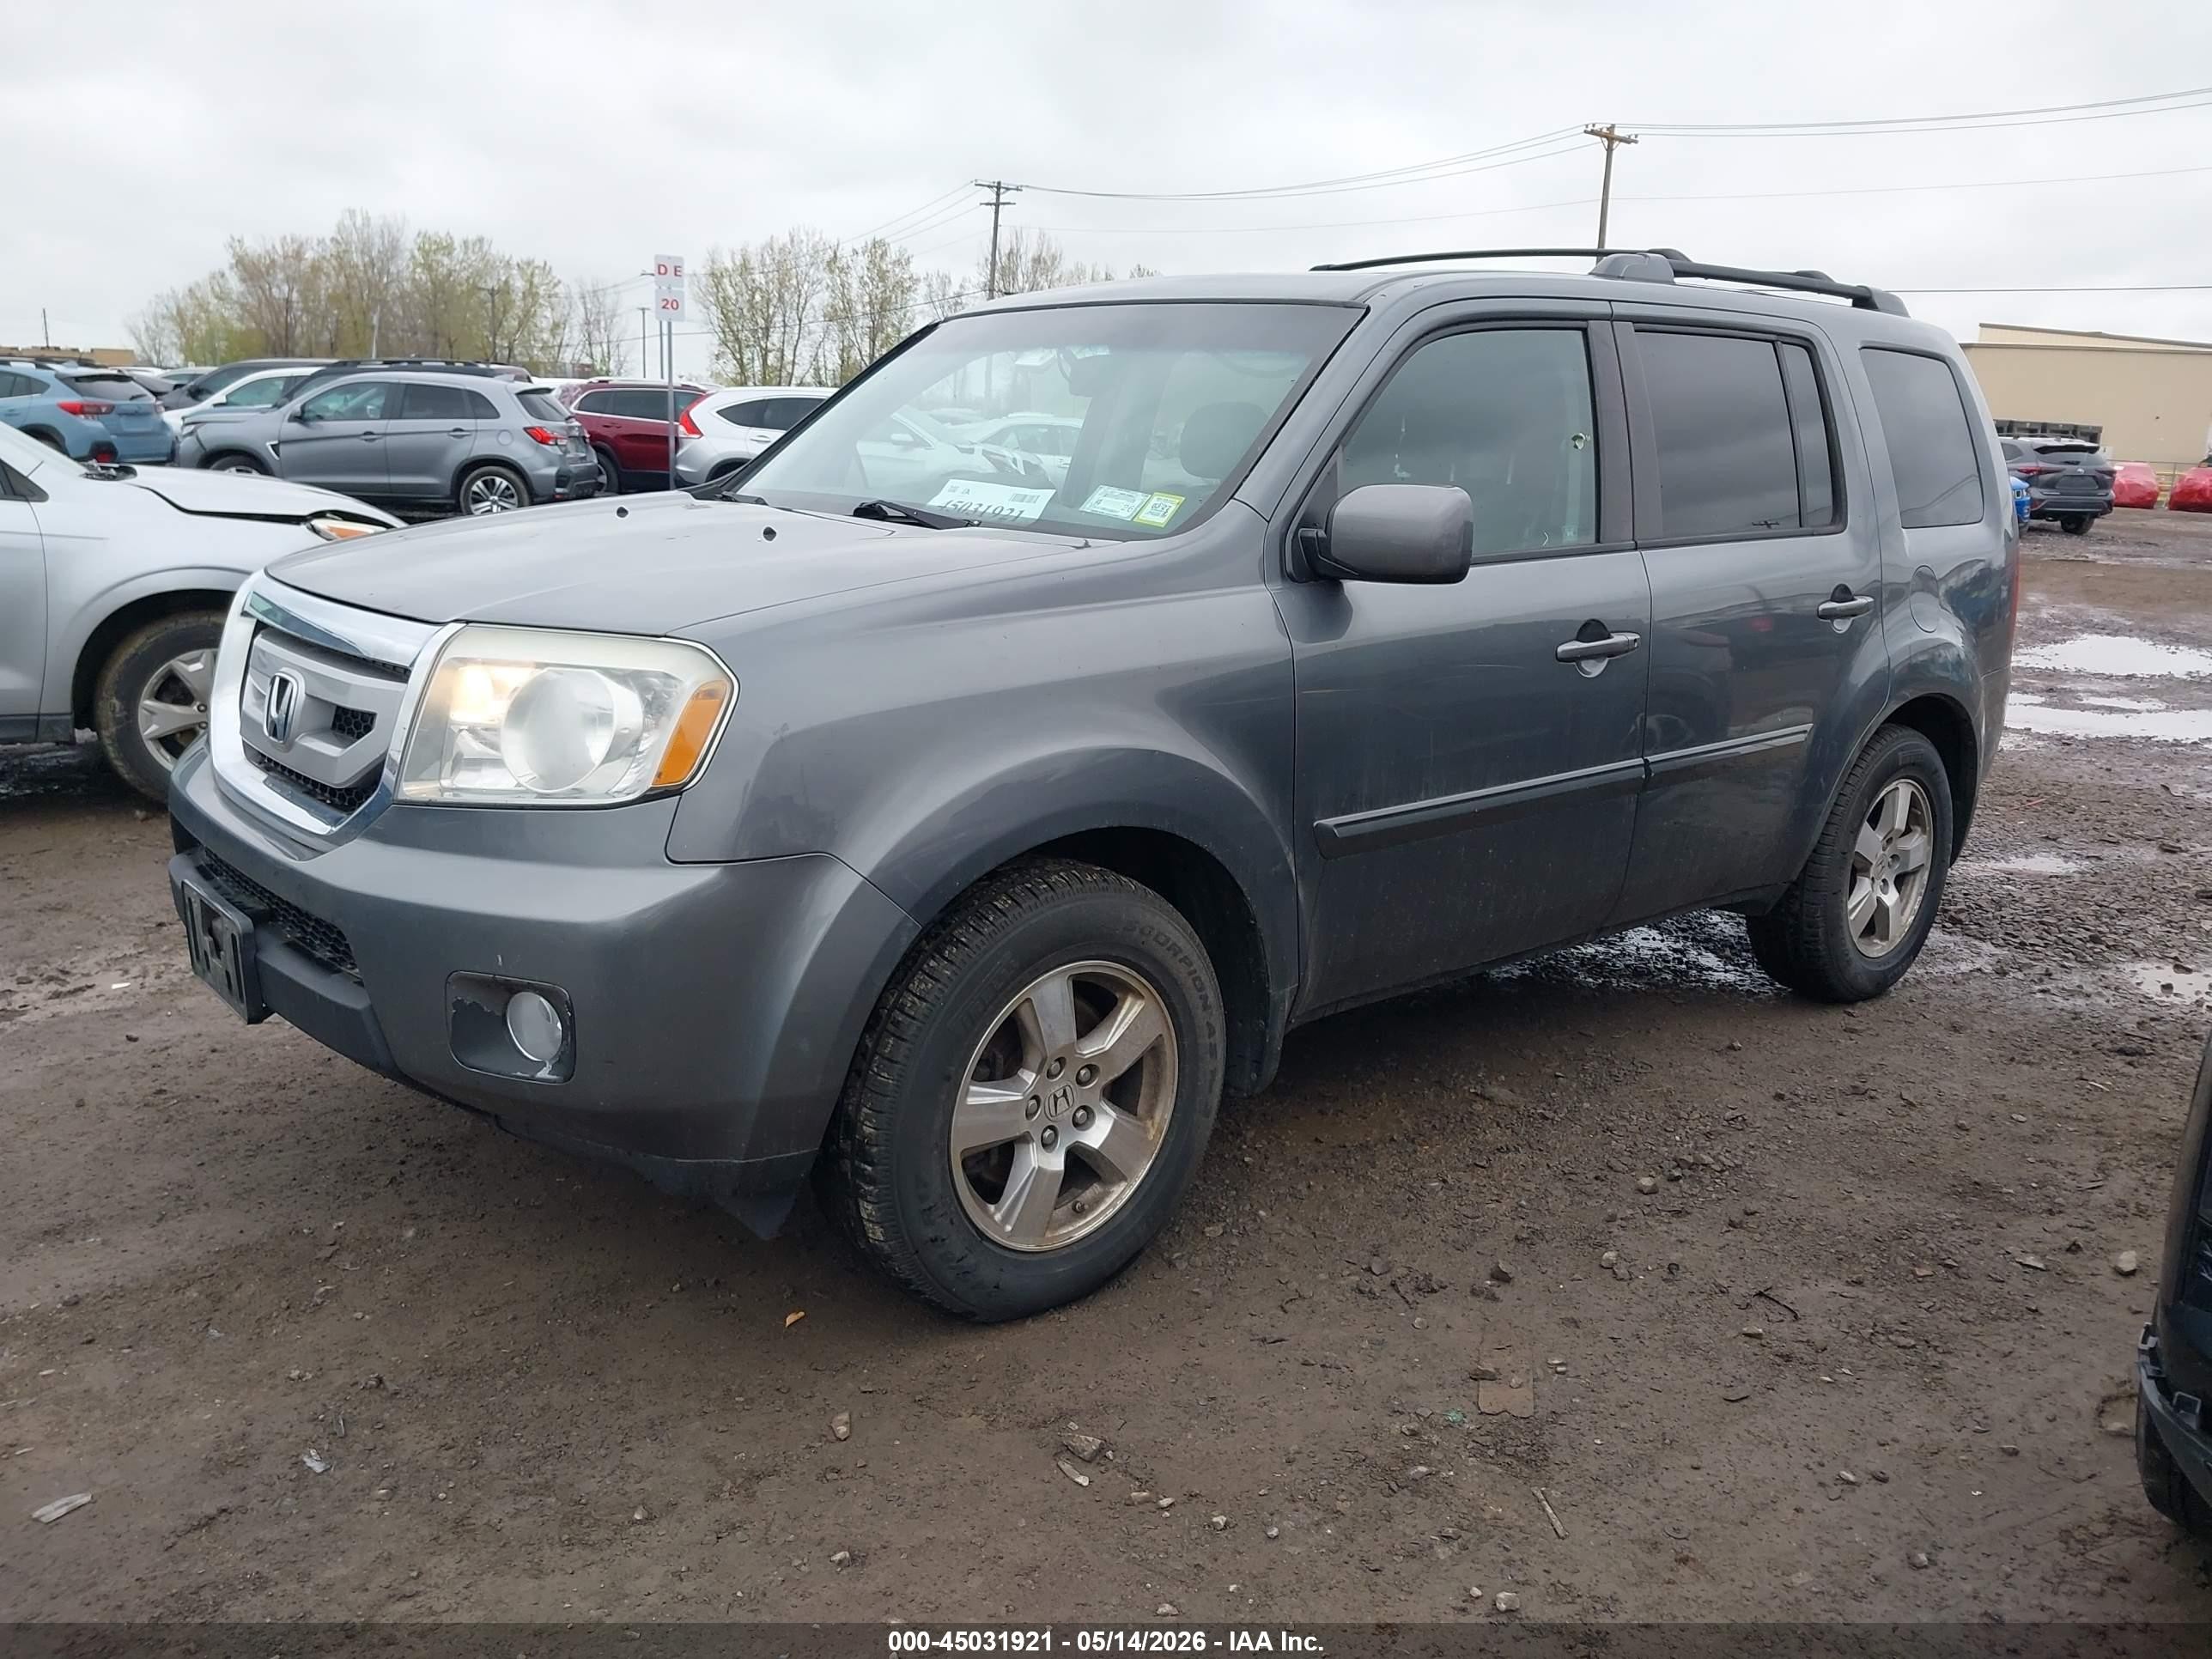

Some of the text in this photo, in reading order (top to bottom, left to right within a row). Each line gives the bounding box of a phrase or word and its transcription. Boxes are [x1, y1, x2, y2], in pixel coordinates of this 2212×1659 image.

[658, 264, 683, 277] D E
[661, 298, 679, 311] 20
